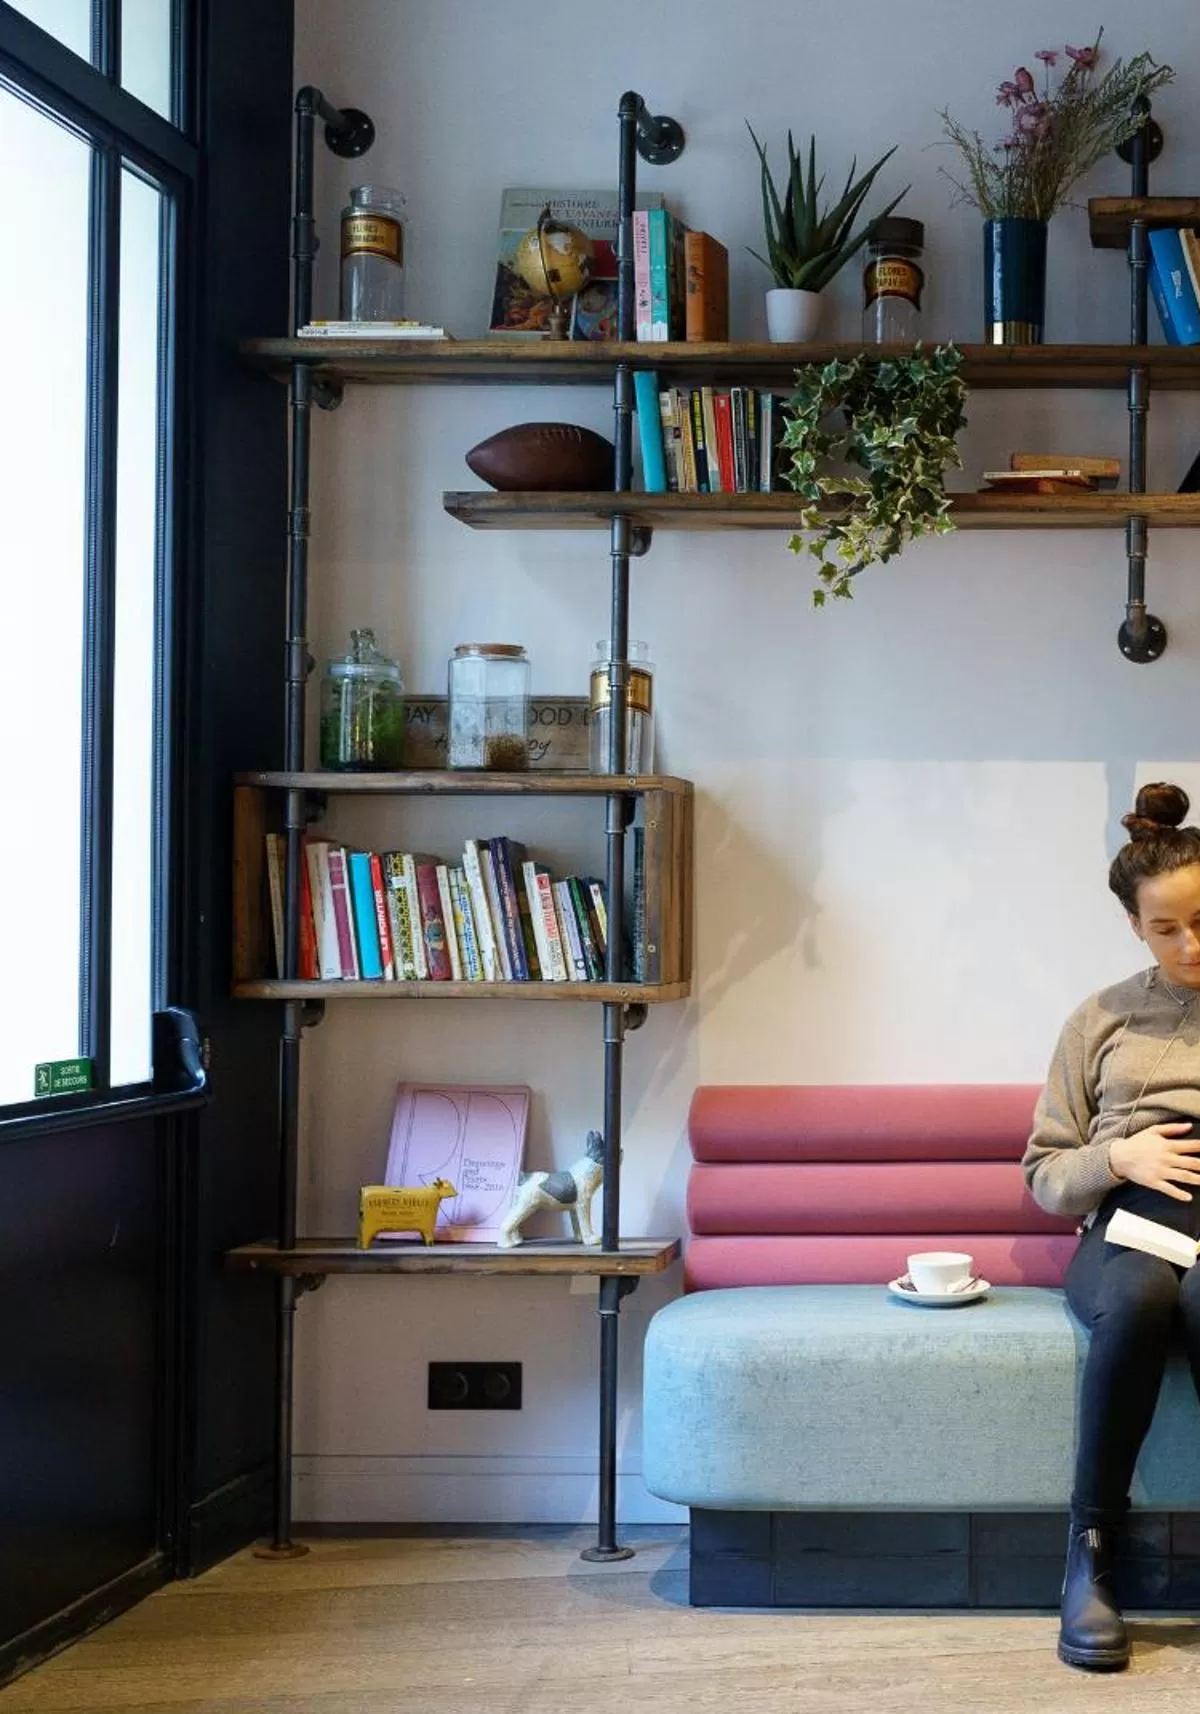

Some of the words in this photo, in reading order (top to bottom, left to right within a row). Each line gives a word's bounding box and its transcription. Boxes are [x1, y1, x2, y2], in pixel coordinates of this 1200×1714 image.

[407, 705, 436, 725] AY
[60, 1065, 80, 1075] SORTIE
[54, 1079, 61, 1088] DE
[61, 1075, 88, 1087] SECOURS
